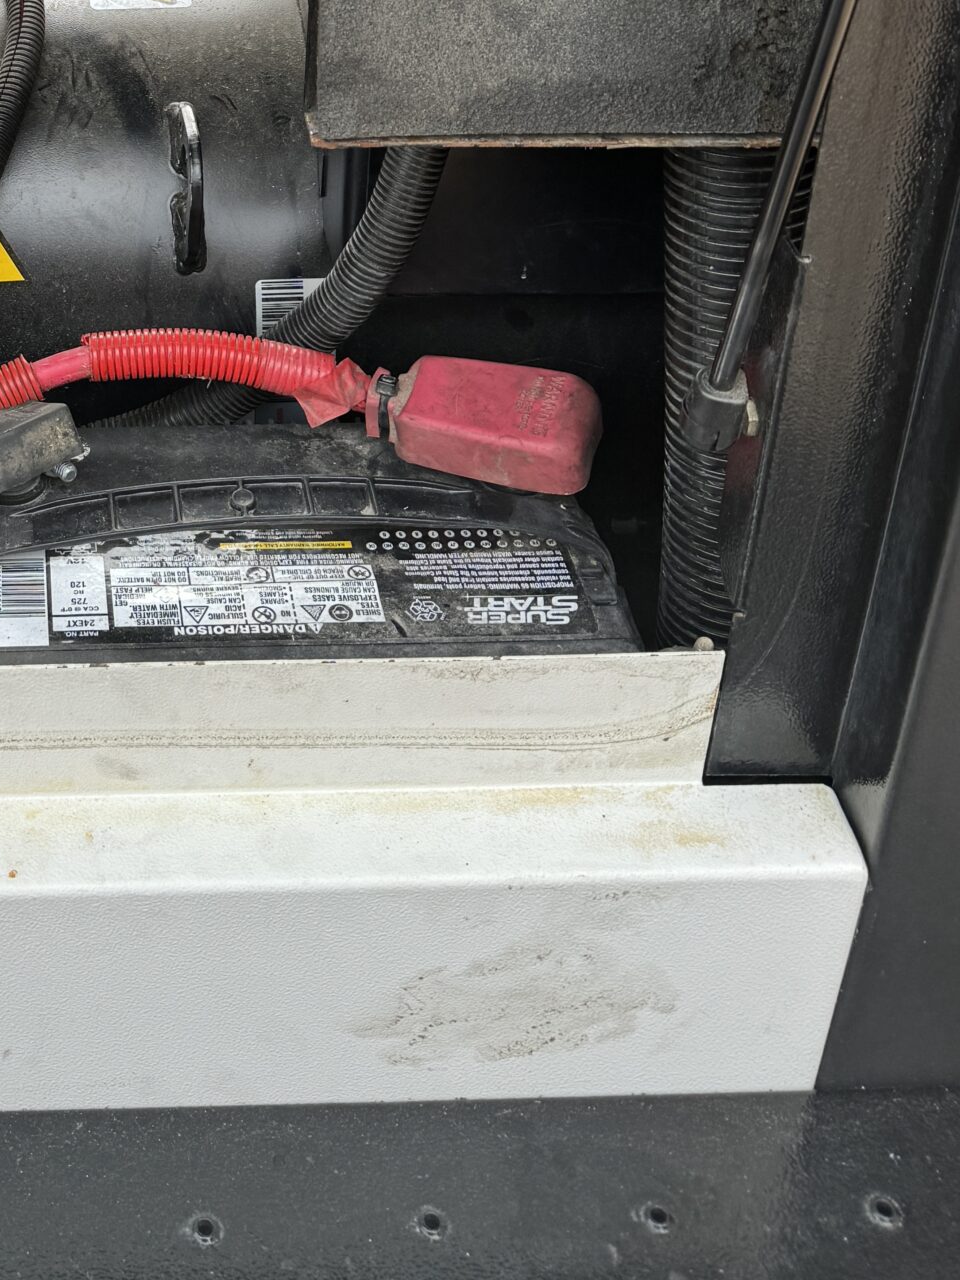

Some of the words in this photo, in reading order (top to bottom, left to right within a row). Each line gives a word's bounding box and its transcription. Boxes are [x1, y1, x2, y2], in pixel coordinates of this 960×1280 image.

[463, 595, 578, 612] START
[129, 611, 178, 619] IMMEDIATELY
[467, 611, 570, 625] SUPER
[66, 620, 95, 628] 24EXT
[174, 624, 306, 636] DANGER/POISON
